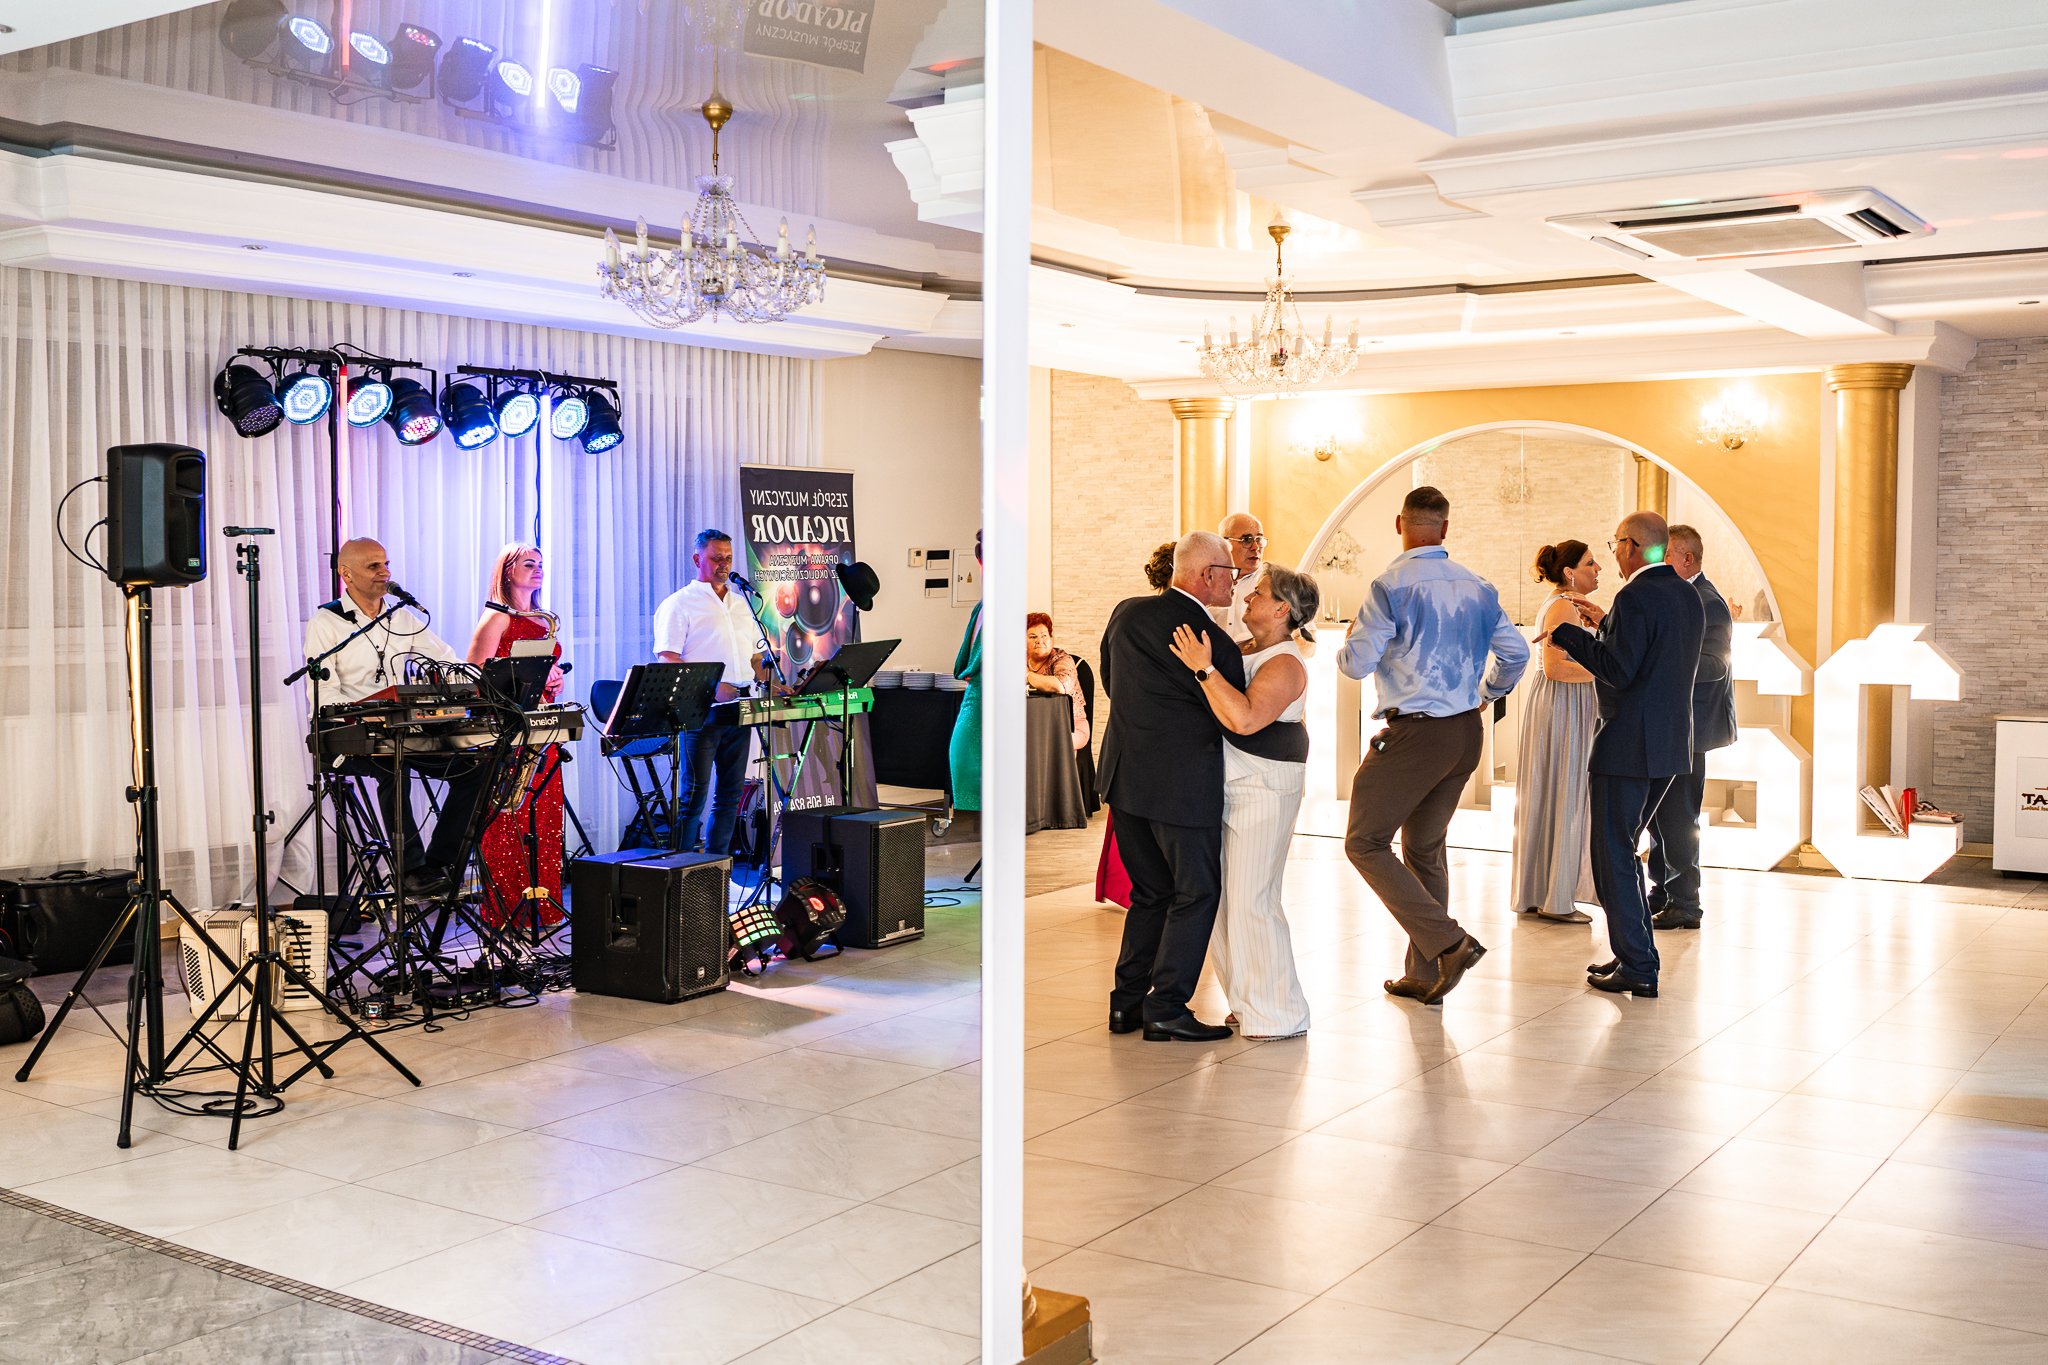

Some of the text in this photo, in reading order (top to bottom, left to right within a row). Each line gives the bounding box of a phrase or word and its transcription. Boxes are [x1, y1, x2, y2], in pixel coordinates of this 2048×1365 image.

[755, 23, 862, 55] ZESPÓŁ MUZYCZNY
[2021, 792, 2048, 806] TA
